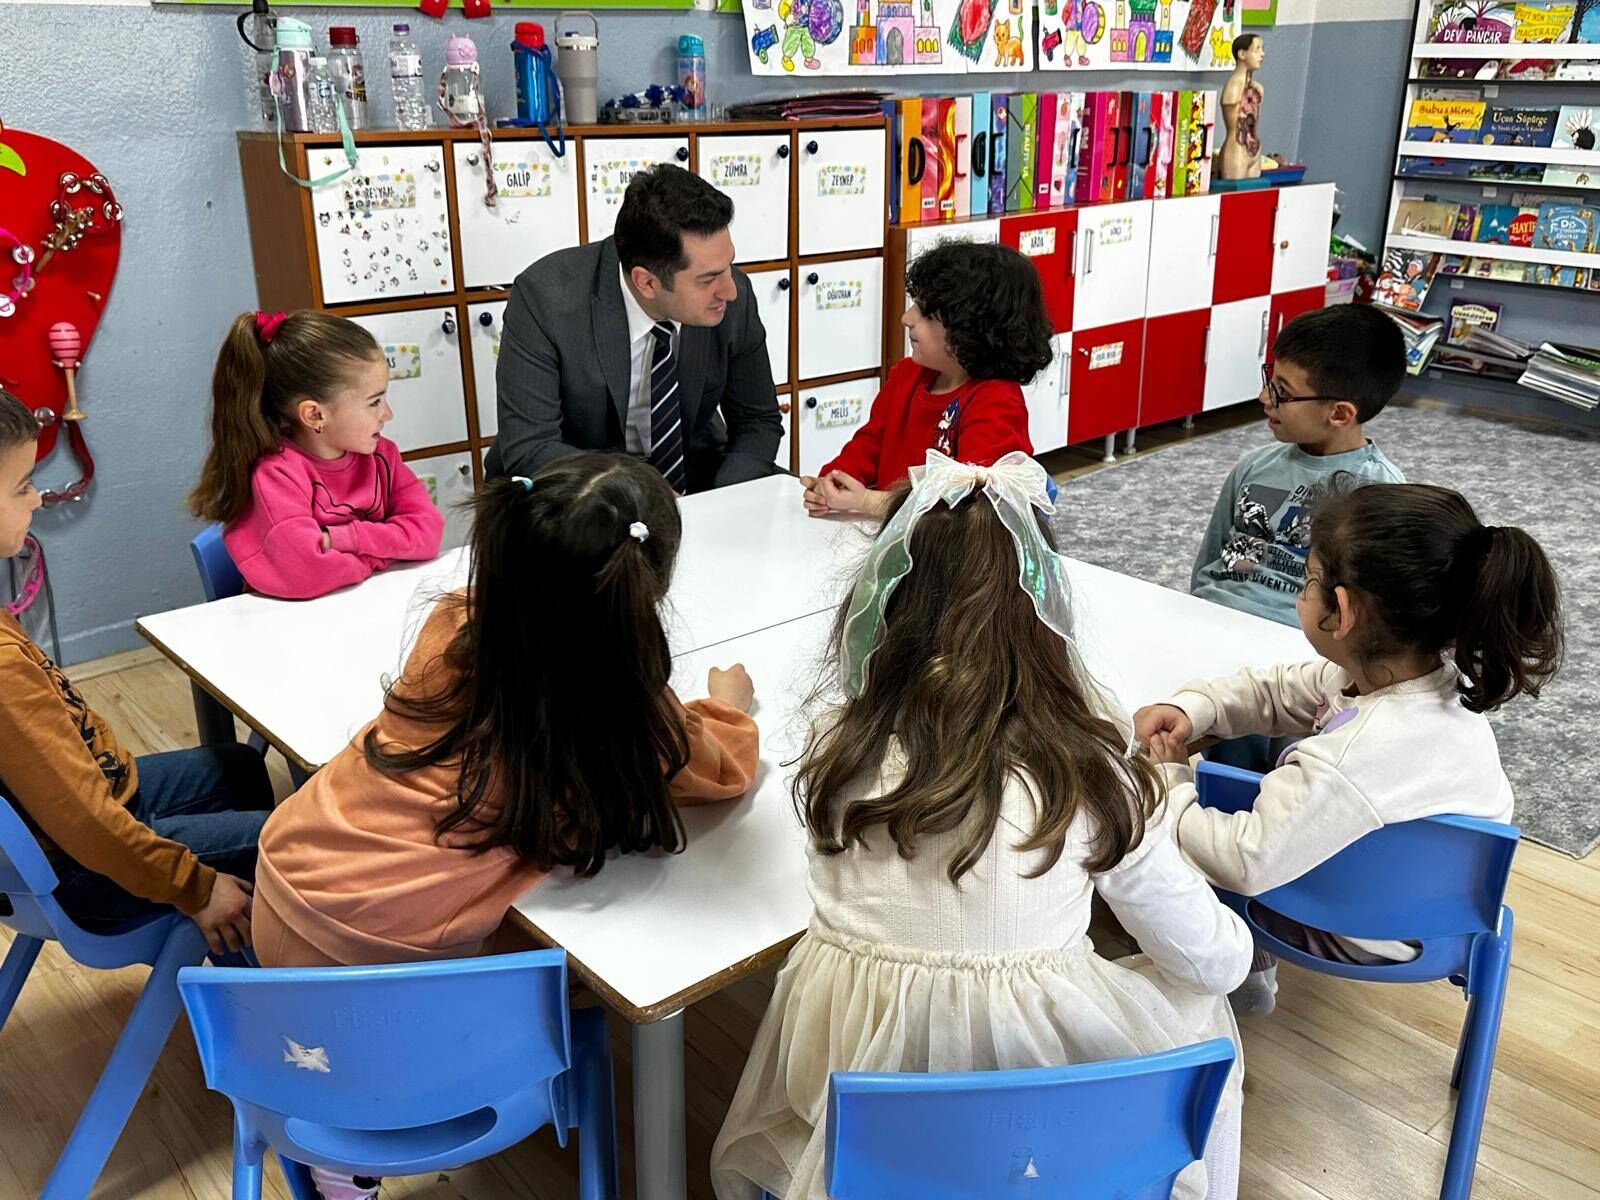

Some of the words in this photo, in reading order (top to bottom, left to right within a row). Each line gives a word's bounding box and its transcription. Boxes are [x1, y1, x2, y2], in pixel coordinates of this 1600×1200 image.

[1443, 29, 1463, 42] DEV
[1465, 30, 1502, 44] PANCAR
[724, 161, 748, 178] ZÜMRA
[506, 172, 531, 188] GALİP
[831, 171, 854, 187] ZEYNEP
